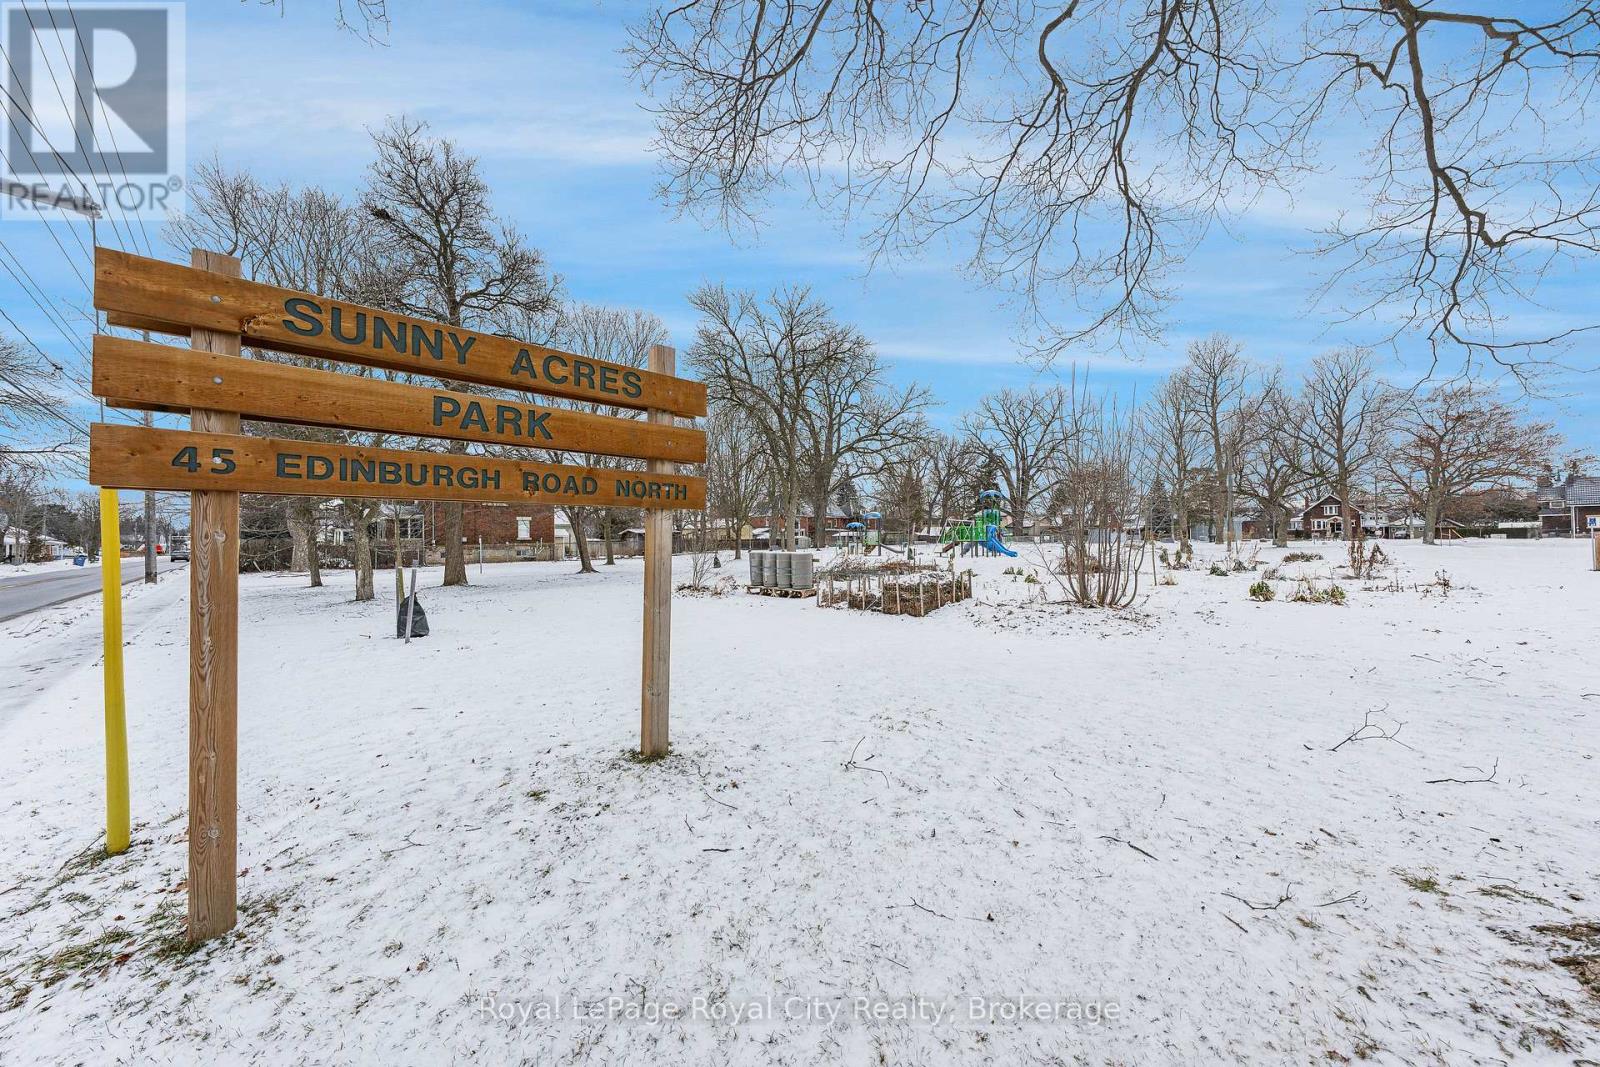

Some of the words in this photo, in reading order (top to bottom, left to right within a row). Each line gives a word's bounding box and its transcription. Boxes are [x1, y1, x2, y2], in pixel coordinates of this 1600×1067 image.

[282, 297, 476, 365] SUNNY
[510, 349, 643, 399] ACRES
[433, 395, 553, 440] PARK
[171, 446, 237, 475] 45
[276, 452, 501, 490] EDINBURGH
[522, 471, 598, 496] ROAD
[615, 479, 687, 501] NORTH
